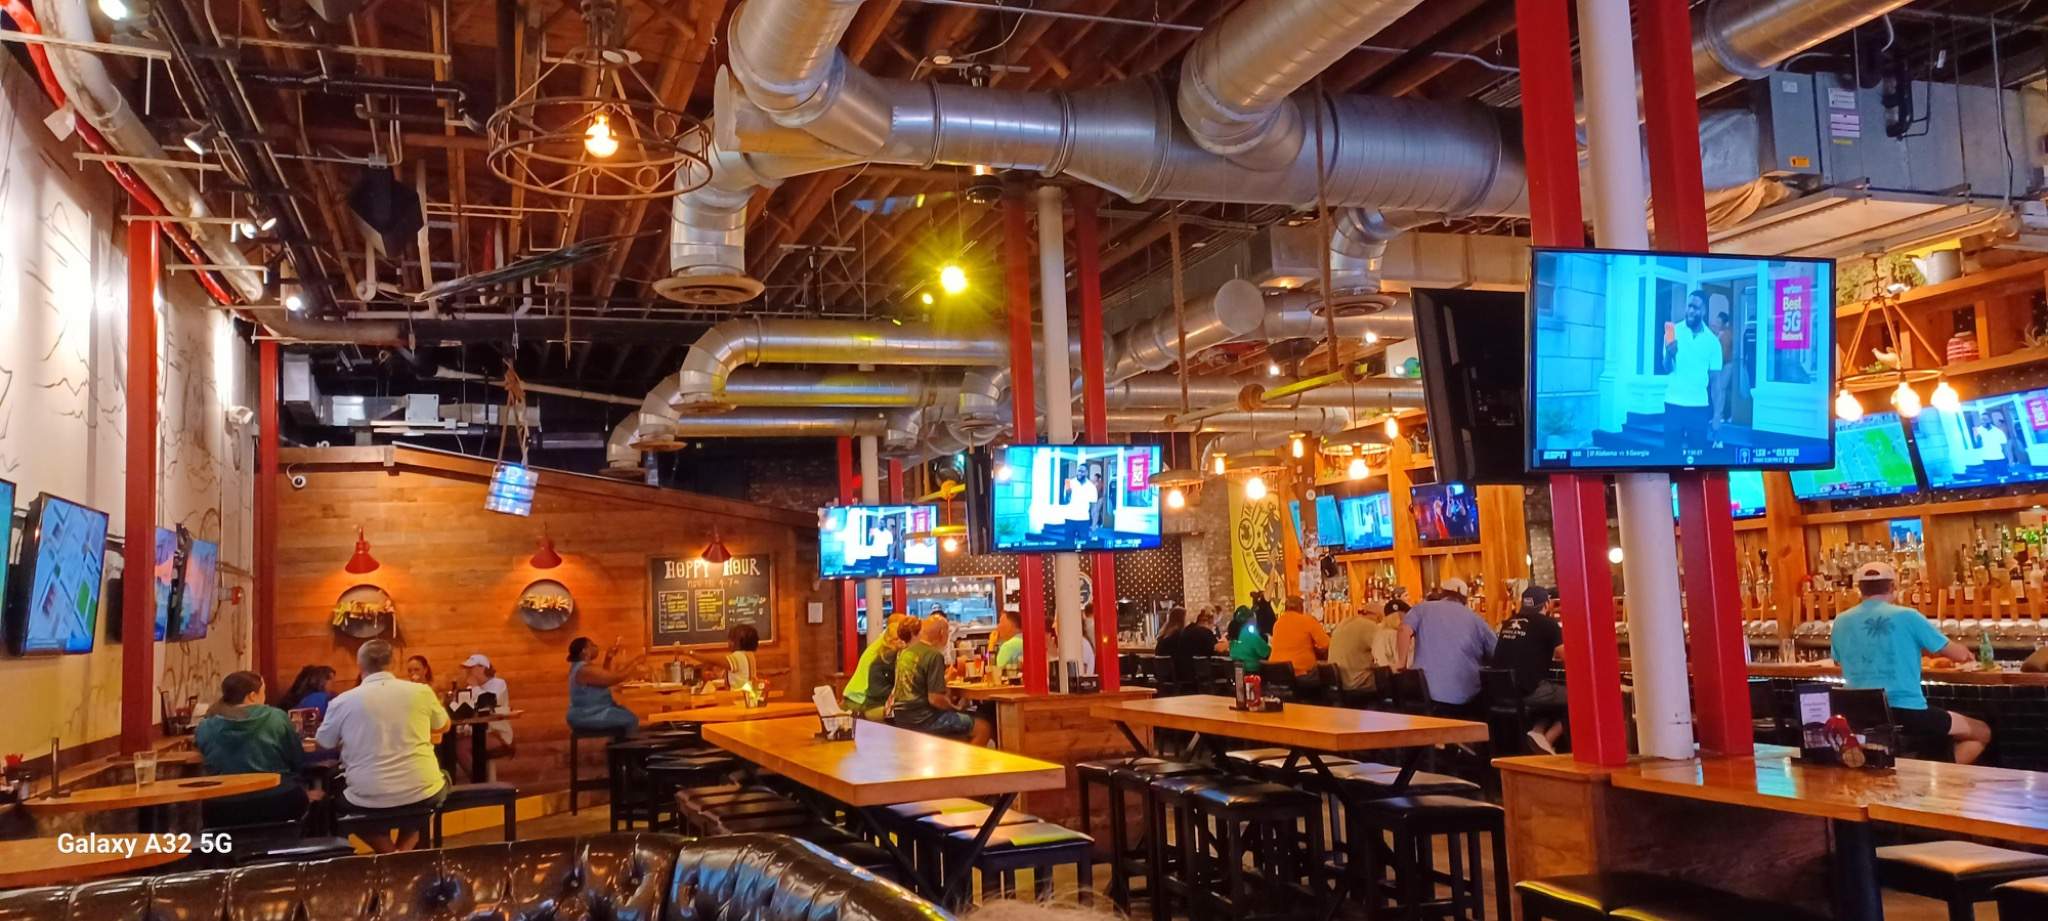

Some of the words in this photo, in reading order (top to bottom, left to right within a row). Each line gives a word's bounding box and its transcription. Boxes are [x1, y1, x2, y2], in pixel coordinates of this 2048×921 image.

[1783, 296, 1801, 310] Best
[1783, 311, 1801, 332] 5G
[1543, 450, 1567, 460] ESPN
[664, 560, 710, 579] HOPPY
[723, 558, 761, 577] HOUR
